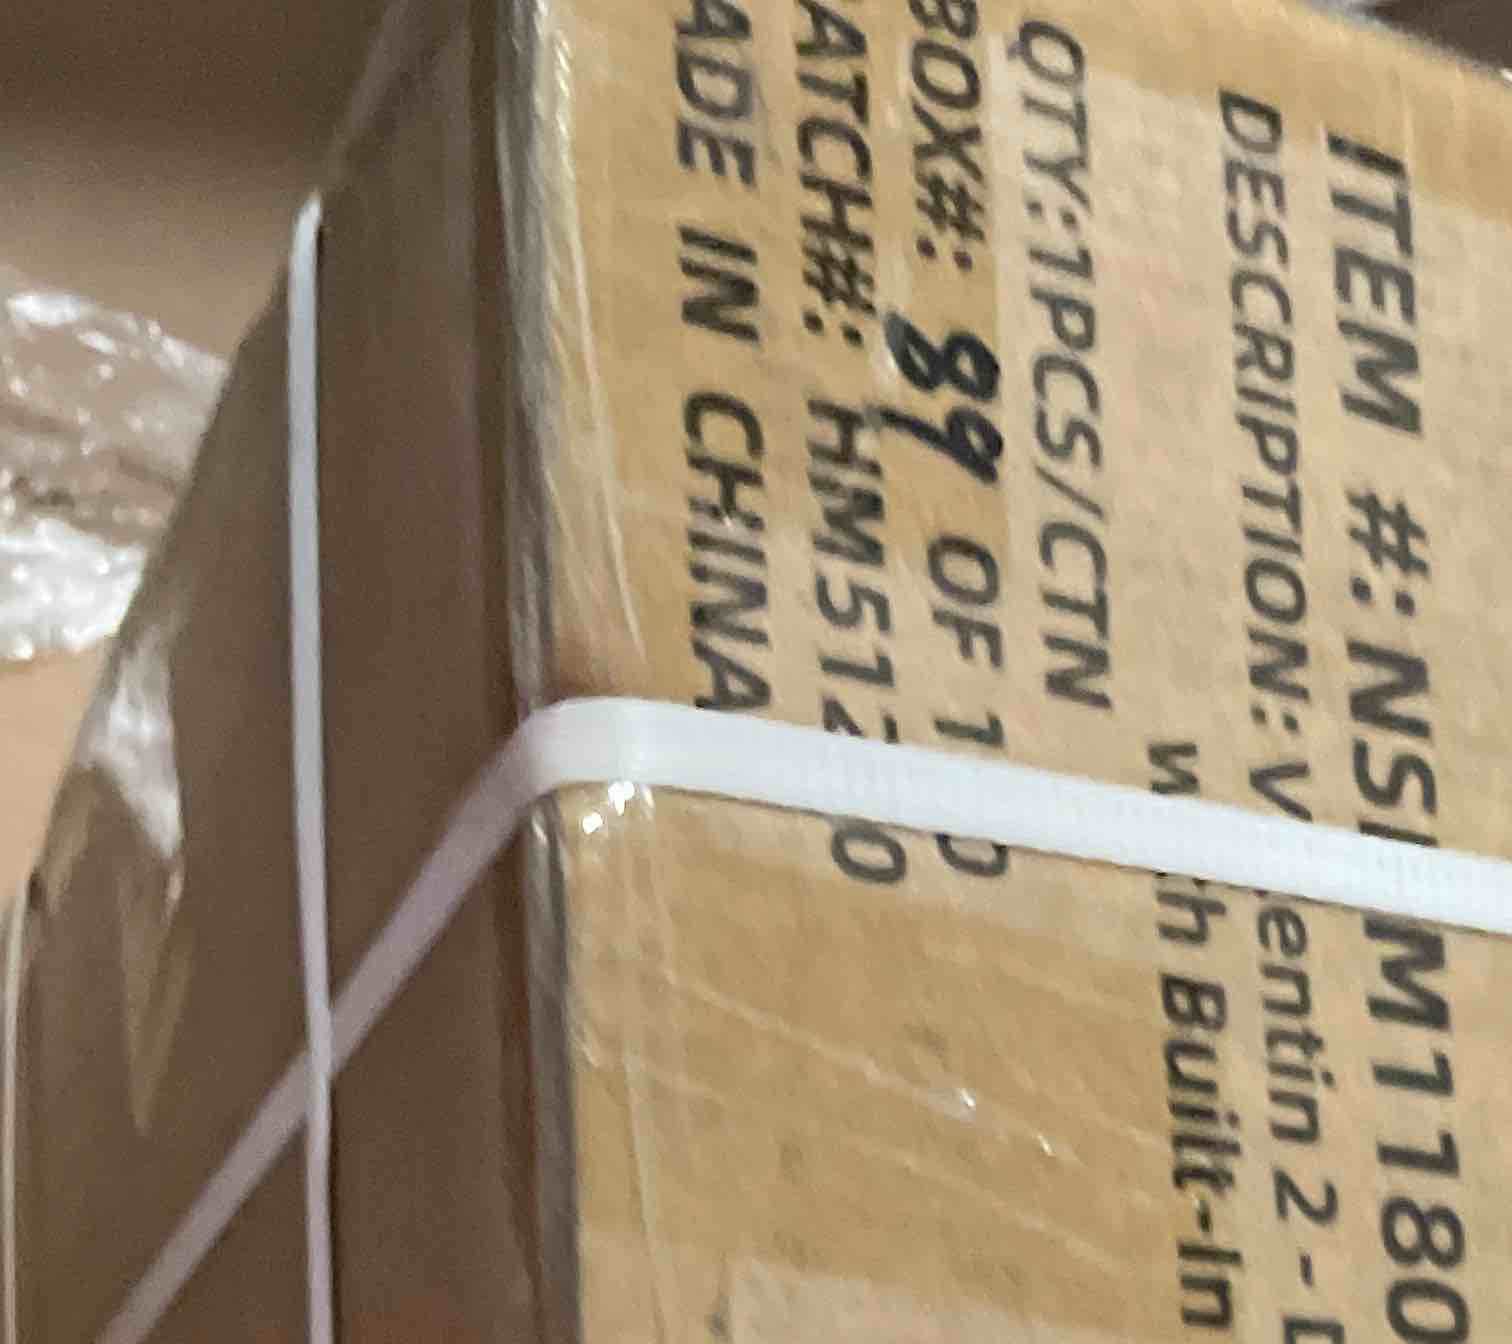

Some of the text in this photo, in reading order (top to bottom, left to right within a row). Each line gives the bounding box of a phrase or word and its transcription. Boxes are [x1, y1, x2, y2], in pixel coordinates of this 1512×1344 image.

[909, 0, 987, 273] BOX#:
[1325, 131, 1426, 438] ITEM
[675, 0, 774, 714] ADE IN CHINA
[794, 0, 908, 887] ATCH#: HM5120
[865, 313, 1006, 487] 89
[1006, 20, 1113, 713] QTY:1PCS/CTN
[1218, 85, 1310, 740] DESCRIPTION:
[927, 535, 1010, 880] OF 10
[1146, 740, 1227, 945] wh
[1248, 757, 1335, 1146] Ventin
[1159, 971, 1243, 1330] Built-In
[1274, 1164, 1340, 1228] 2
